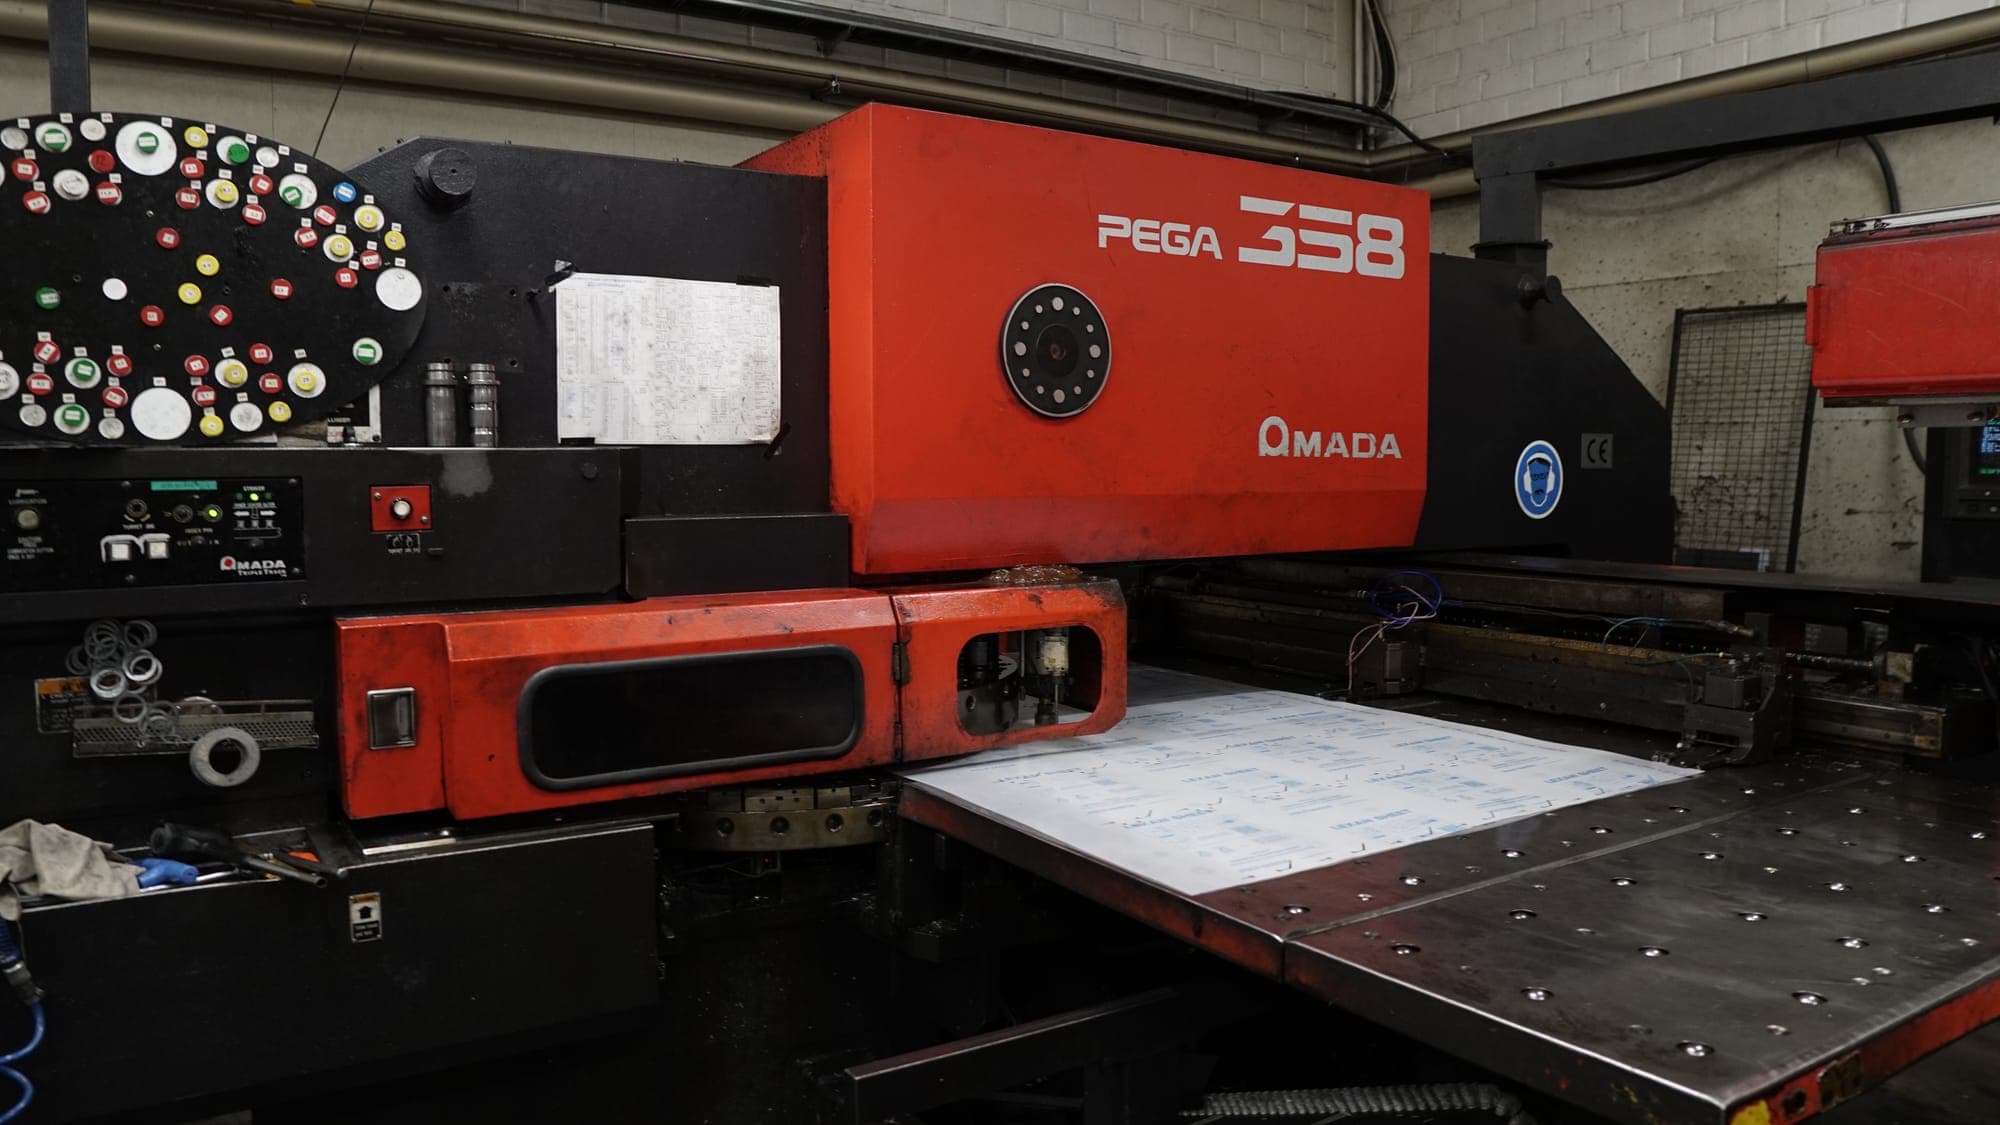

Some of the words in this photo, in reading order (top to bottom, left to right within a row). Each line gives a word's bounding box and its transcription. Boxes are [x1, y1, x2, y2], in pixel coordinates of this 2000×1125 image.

[1098, 214, 1223, 260] PEGA
[1238, 195, 1405, 279] 358
[1258, 415, 1401, 459] AMADA
[220, 555, 286, 571] AMADA
